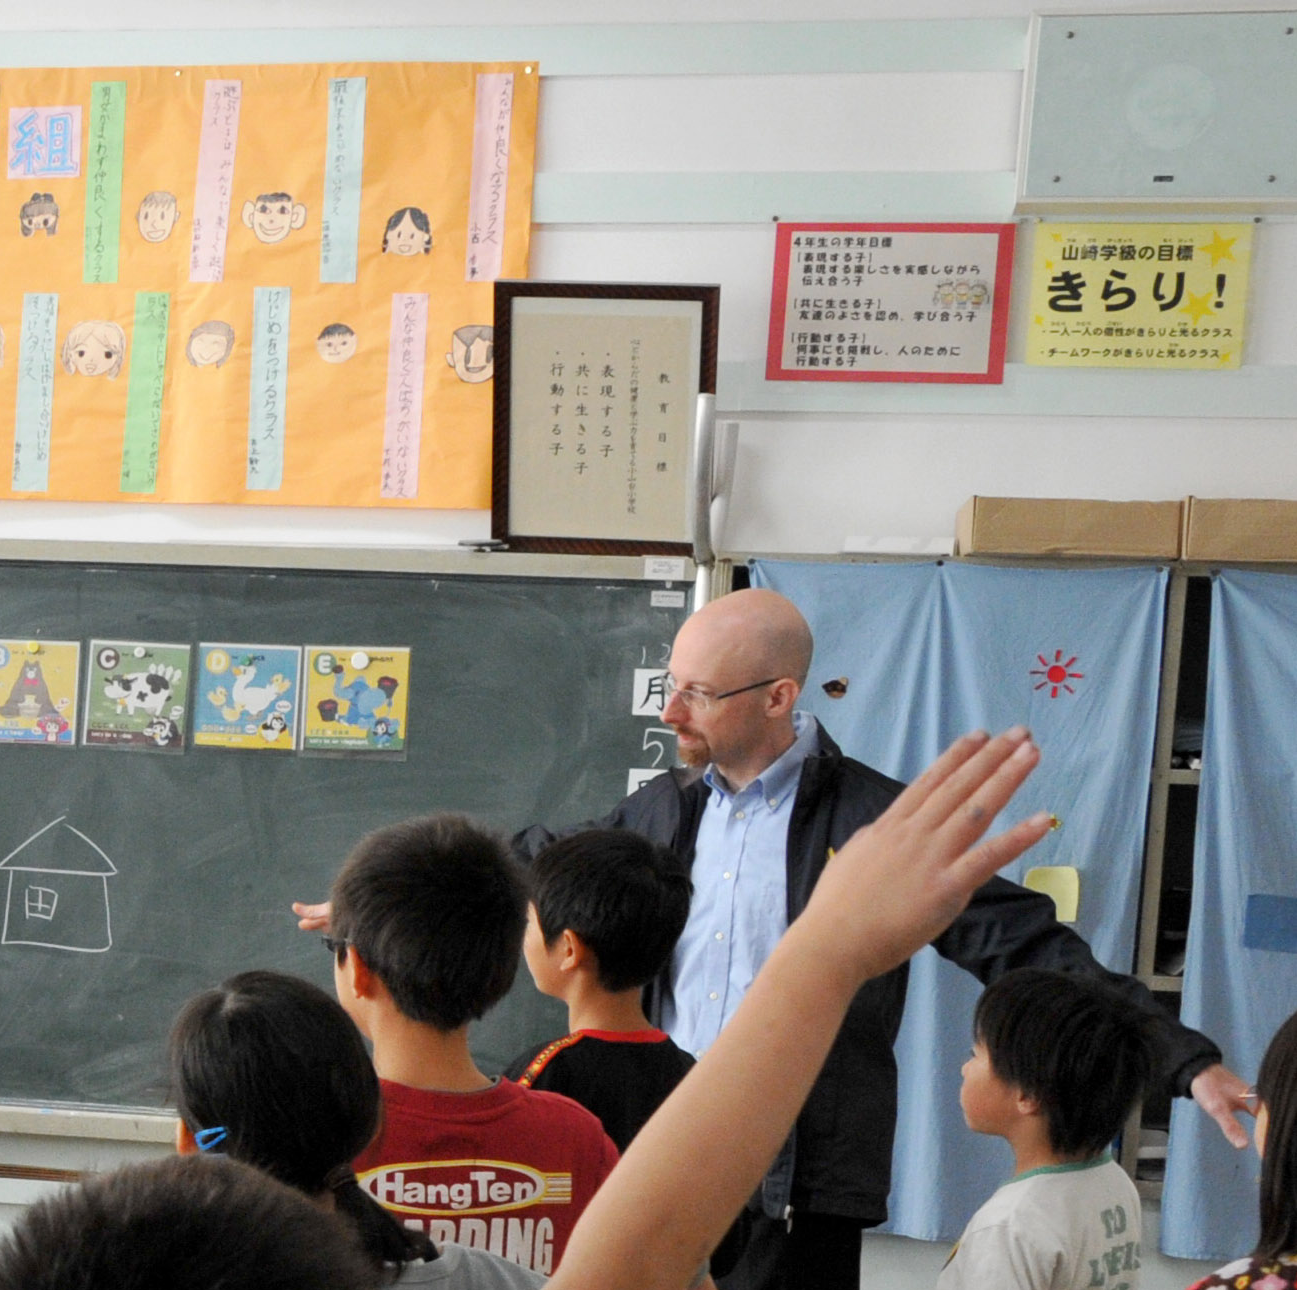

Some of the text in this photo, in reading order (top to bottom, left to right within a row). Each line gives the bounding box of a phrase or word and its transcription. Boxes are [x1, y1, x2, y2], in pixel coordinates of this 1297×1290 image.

[9, 109, 78, 175] 組
[794, 237, 893, 248] 4年生の学年目標
[1061, 244, 1195, 262] 山崎学級の目標
[802, 264, 981, 276] 表現する楽しさを実感しながら
[802, 276, 864, 287] 伝え合う子
[1047, 268, 1227, 312] きらり！
[263, 291, 282, 440] けじめをつけるクラス
[795, 356, 858, 368] 行動する子
[656, 372, 671, 474] 教育目標
[642, 727, 677, 768] 5
